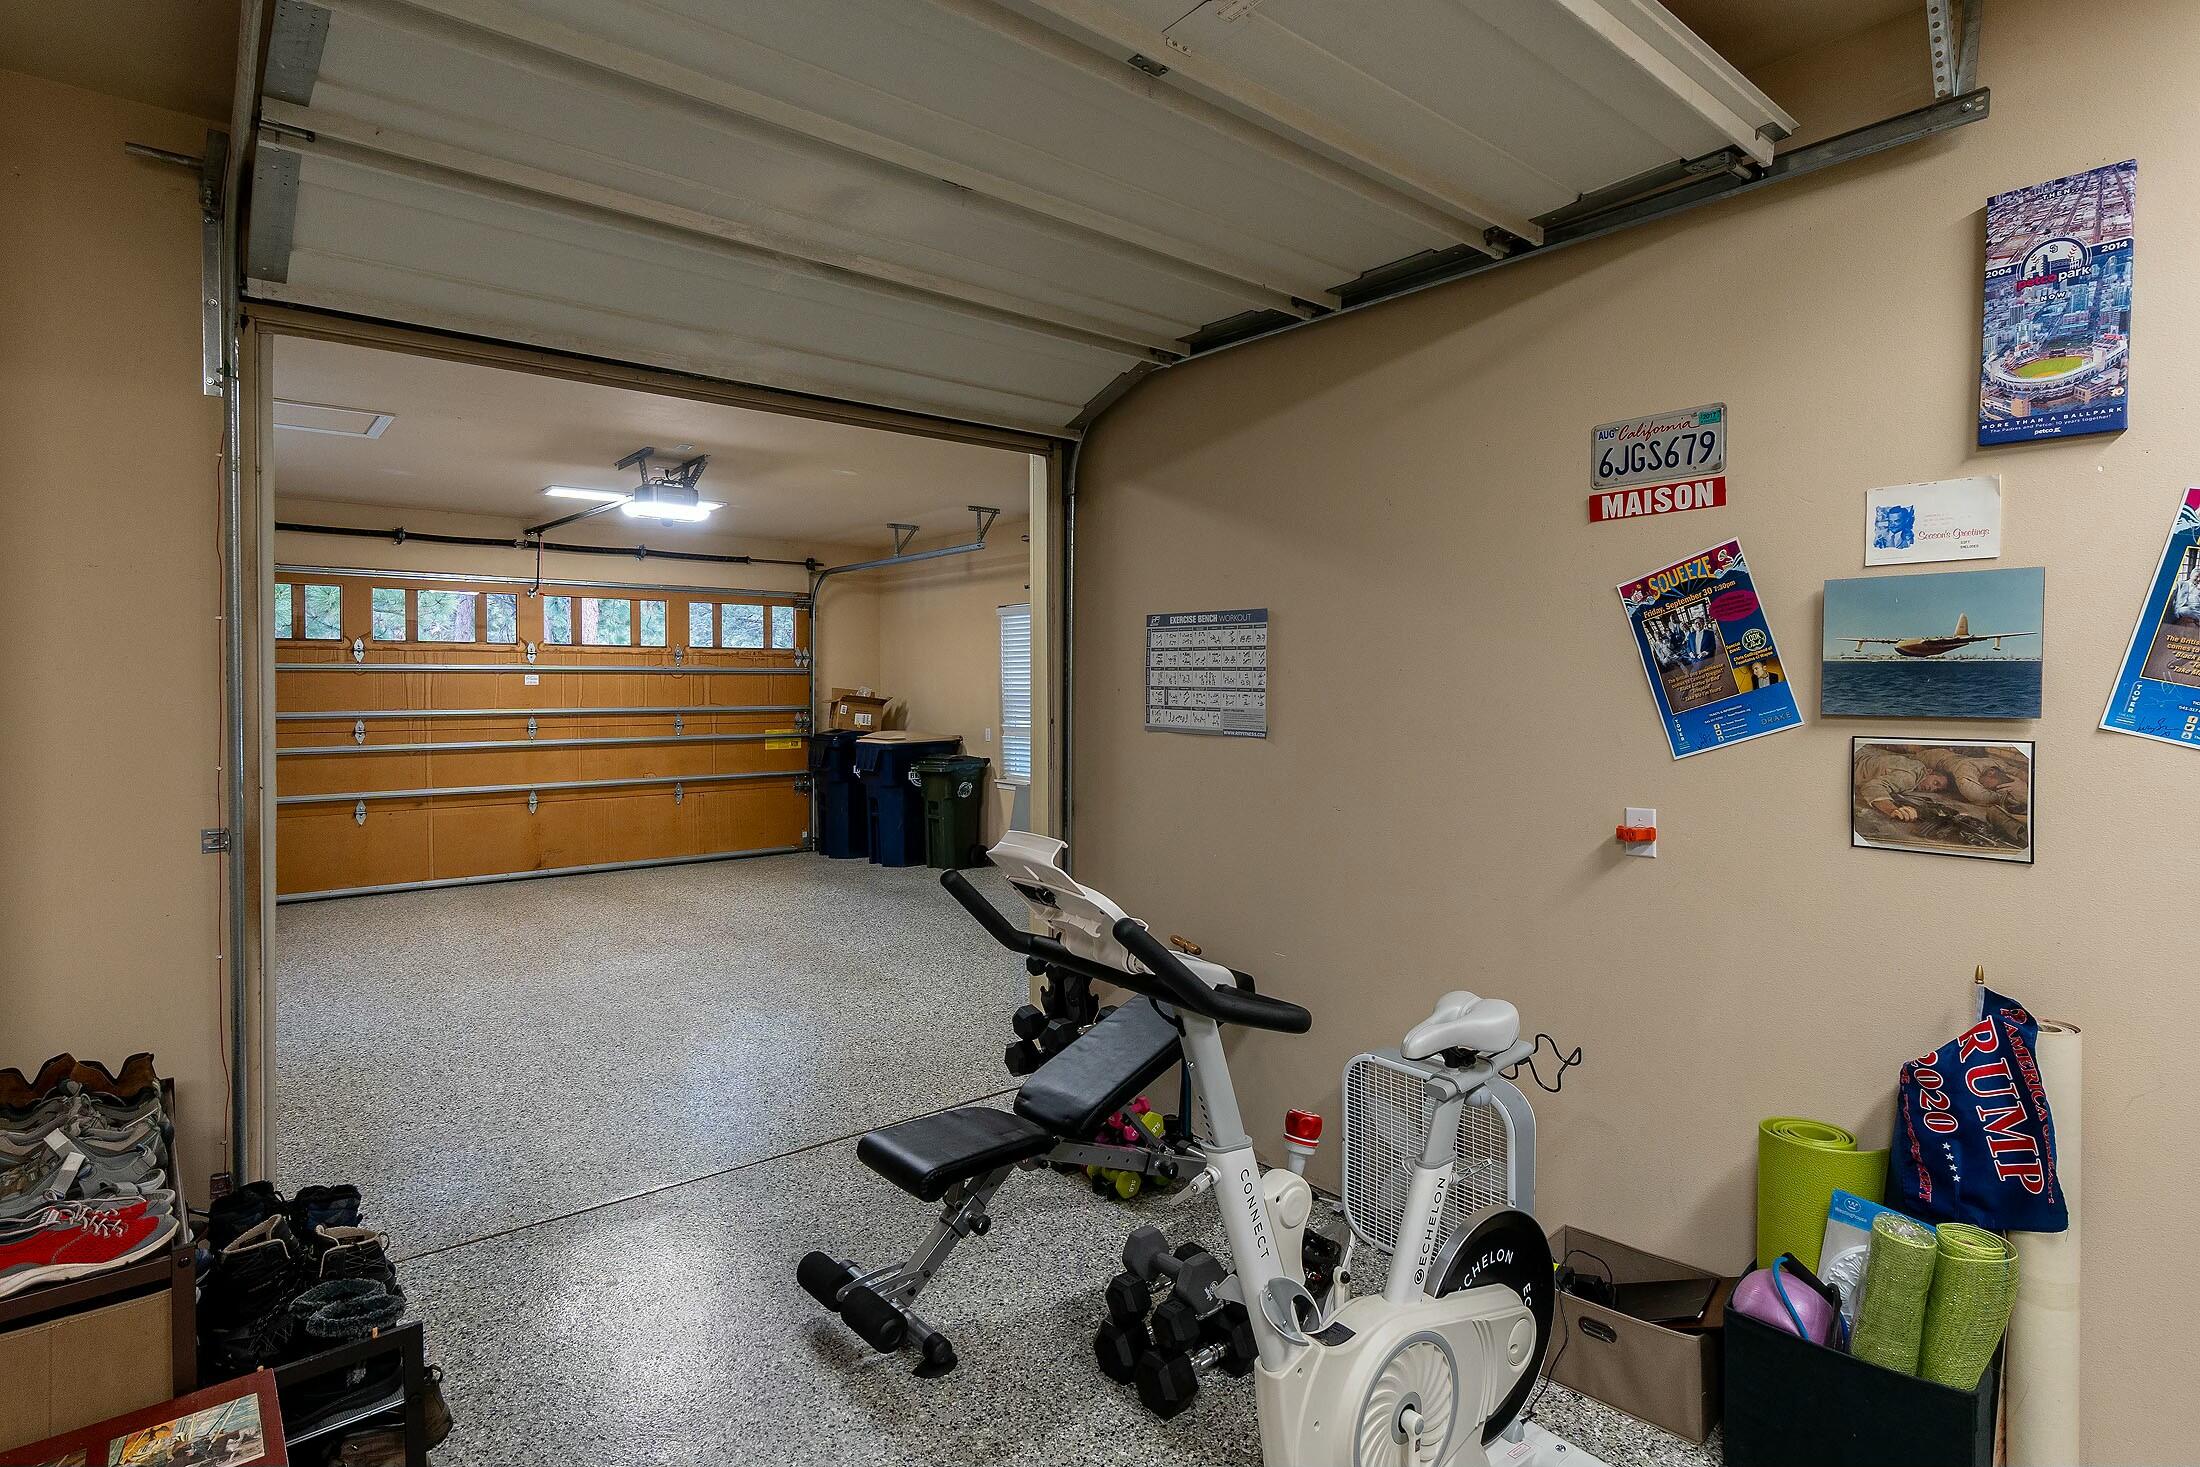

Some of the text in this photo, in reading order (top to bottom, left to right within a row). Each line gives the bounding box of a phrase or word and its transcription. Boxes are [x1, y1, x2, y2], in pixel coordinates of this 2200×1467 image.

[2101, 240, 2128, 253] 2014
[1985, 266, 2012, 278] 2004
[2016, 265, 2091, 292] petco park
[2041, 291, 2066, 302] NOW
[2016, 417, 2043, 425] THAN
[2063, 406, 2122, 419] BALLPARK
[1598, 429, 1615, 440] AUG
[1618, 420, 1700, 441] California
[2034, 428, 2054, 436] petco
[1598, 430, 1716, 478] 6JGS679
[1601, 480, 1714, 520] MAISON
[1918, 527, 1990, 540] Season's Greetings
[1648, 555, 1718, 601] SQUEEZE
[1643, 606, 1666, 619] Friday,
[1665, 592, 1702, 610] September
[1702, 587, 1713, 596] 30
[1170, 615, 1197, 624] EXERCISE
[1198, 614, 1217, 623] BENCH
[1218, 614, 1251, 622] WORKOUT
[2166, 634, 2200, 645] The Britis
[2166, 643, 2191, 651] comes
[2128, 684, 2143, 713] TOWER
[1761, 711, 1792, 726] DRAKE
[2003, 1021, 2049, 1122] AMERICA
[1957, 1015, 2045, 1195] RUMP
[1240, 1168, 1270, 1258] CONNECT
[1419, 1177, 1446, 1266] ECHELON
[1458, 1248, 1514, 1291] CHELON
